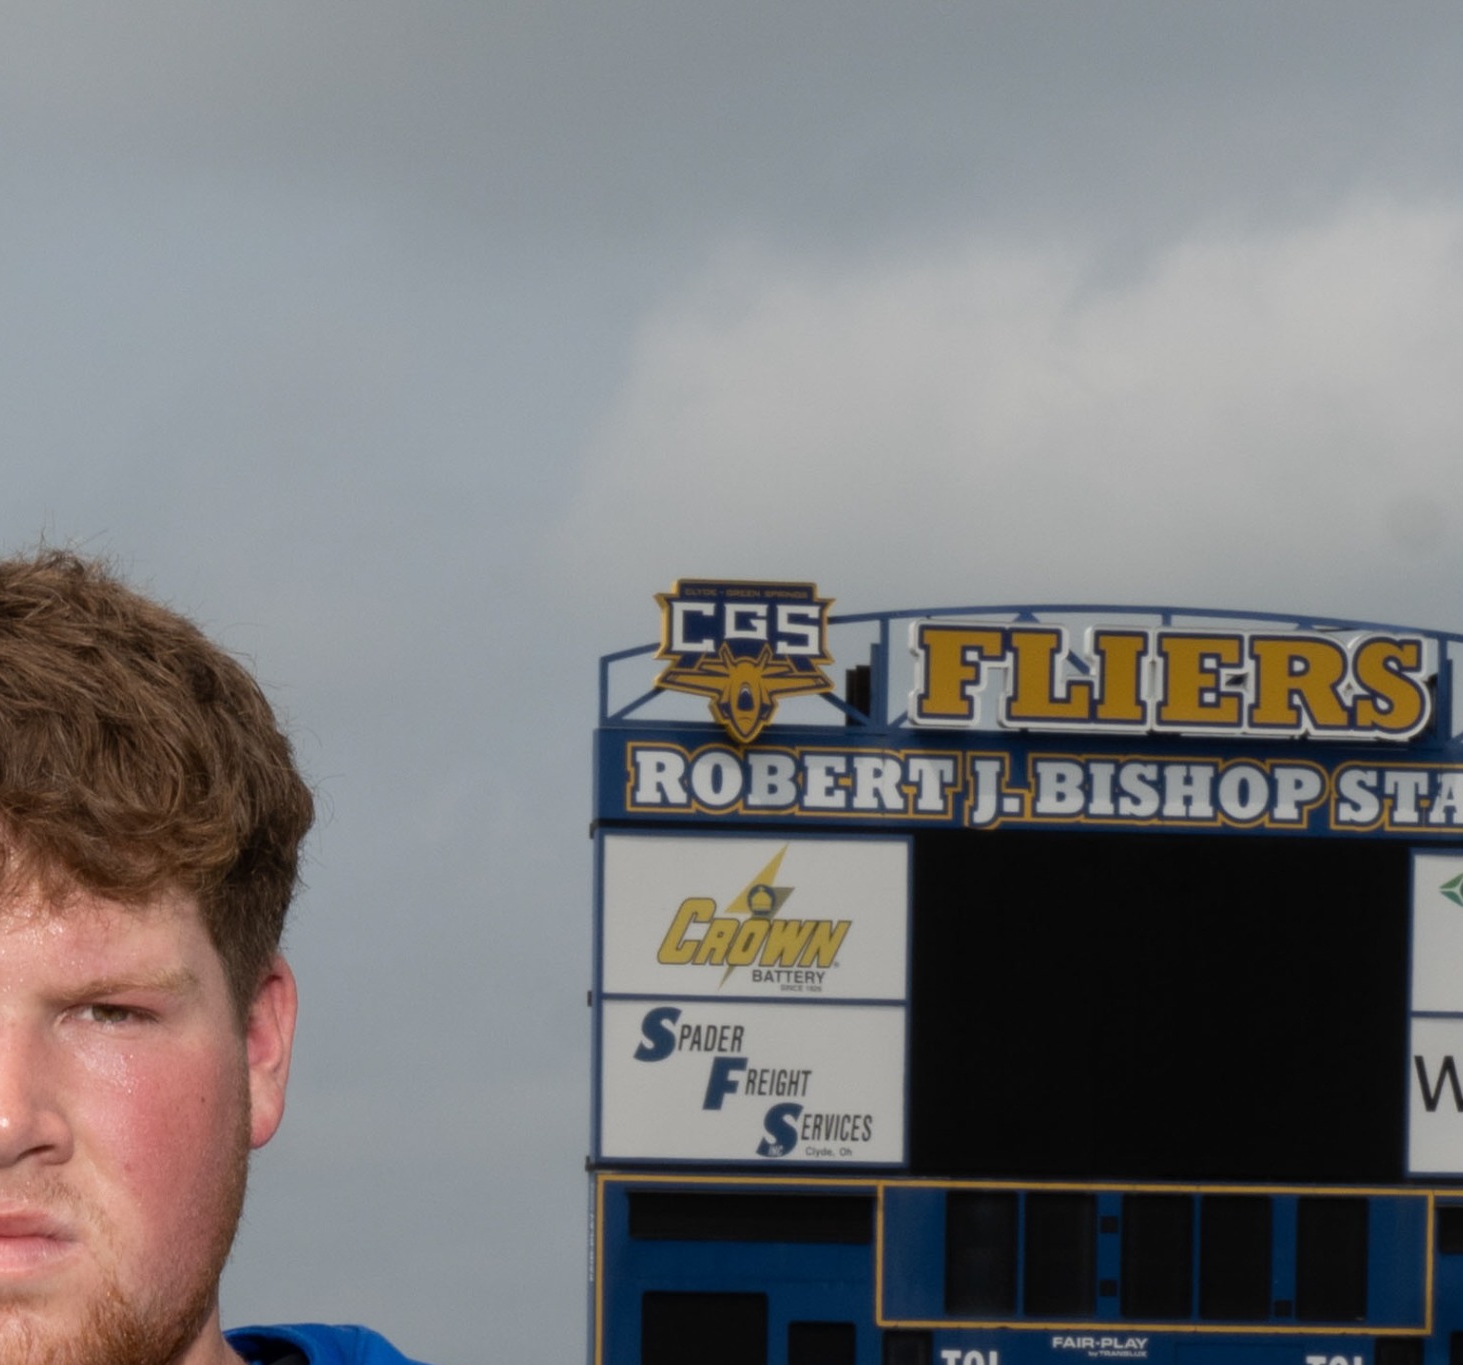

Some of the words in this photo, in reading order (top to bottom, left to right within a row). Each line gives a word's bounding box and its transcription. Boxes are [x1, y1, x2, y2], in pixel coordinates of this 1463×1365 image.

[670, 600, 822, 655] CGS
[909, 618, 1432, 740] FLIERS
[635, 750, 955, 812] ROBERT
[971, 760, 1020, 825] J.
[1037, 760, 1323, 821] BISHOP
[1338, 769, 1463, 825] STA
[657, 897, 852, 968] CROWN
[751, 969, 826, 984] BATTERY
[780, 984, 804, 993] SINCE
[633, 1006, 745, 1062] SPADER
[702, 1056, 812, 1110] FREIGHT
[756, 1102, 873, 1158] SERVICES
[839, 1147, 853, 1157] Oh
[1051, 1336, 1149, 1349] FAIR-PLAY
